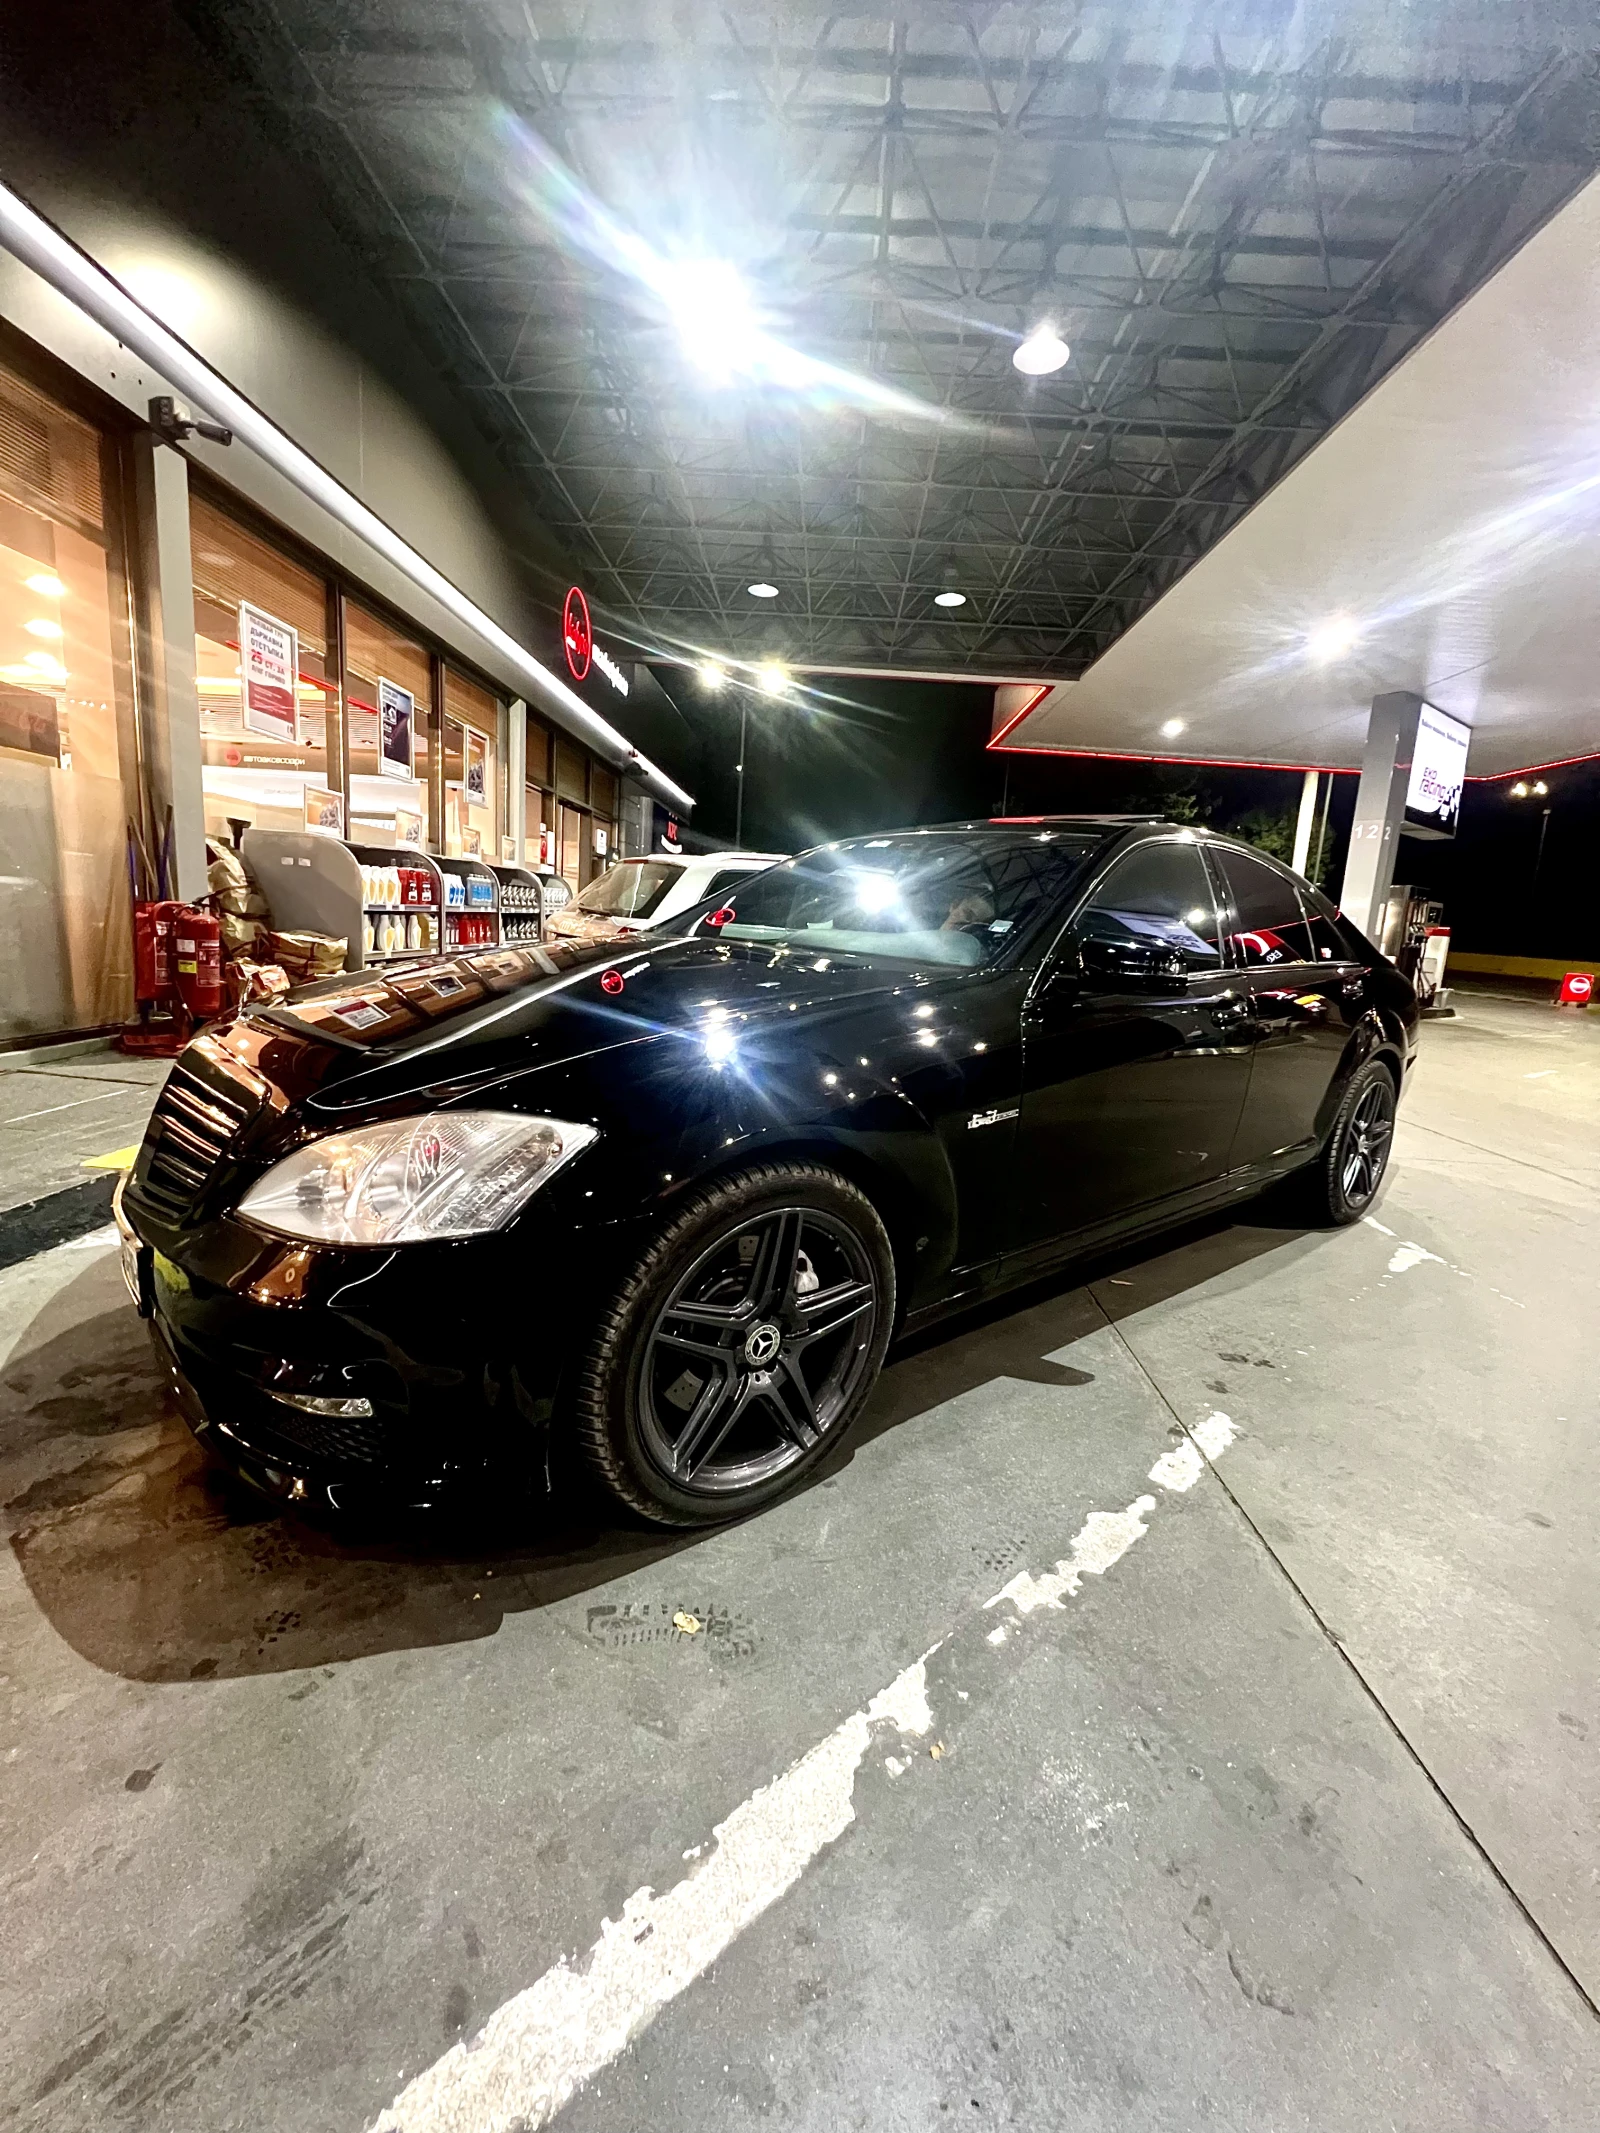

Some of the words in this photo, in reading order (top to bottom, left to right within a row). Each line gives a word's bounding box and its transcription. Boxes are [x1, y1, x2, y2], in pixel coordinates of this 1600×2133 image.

[250, 637, 285, 660] ОТСТЪПКА
[251, 648, 263, 665] 25
[1419, 778, 1447, 803] racing
